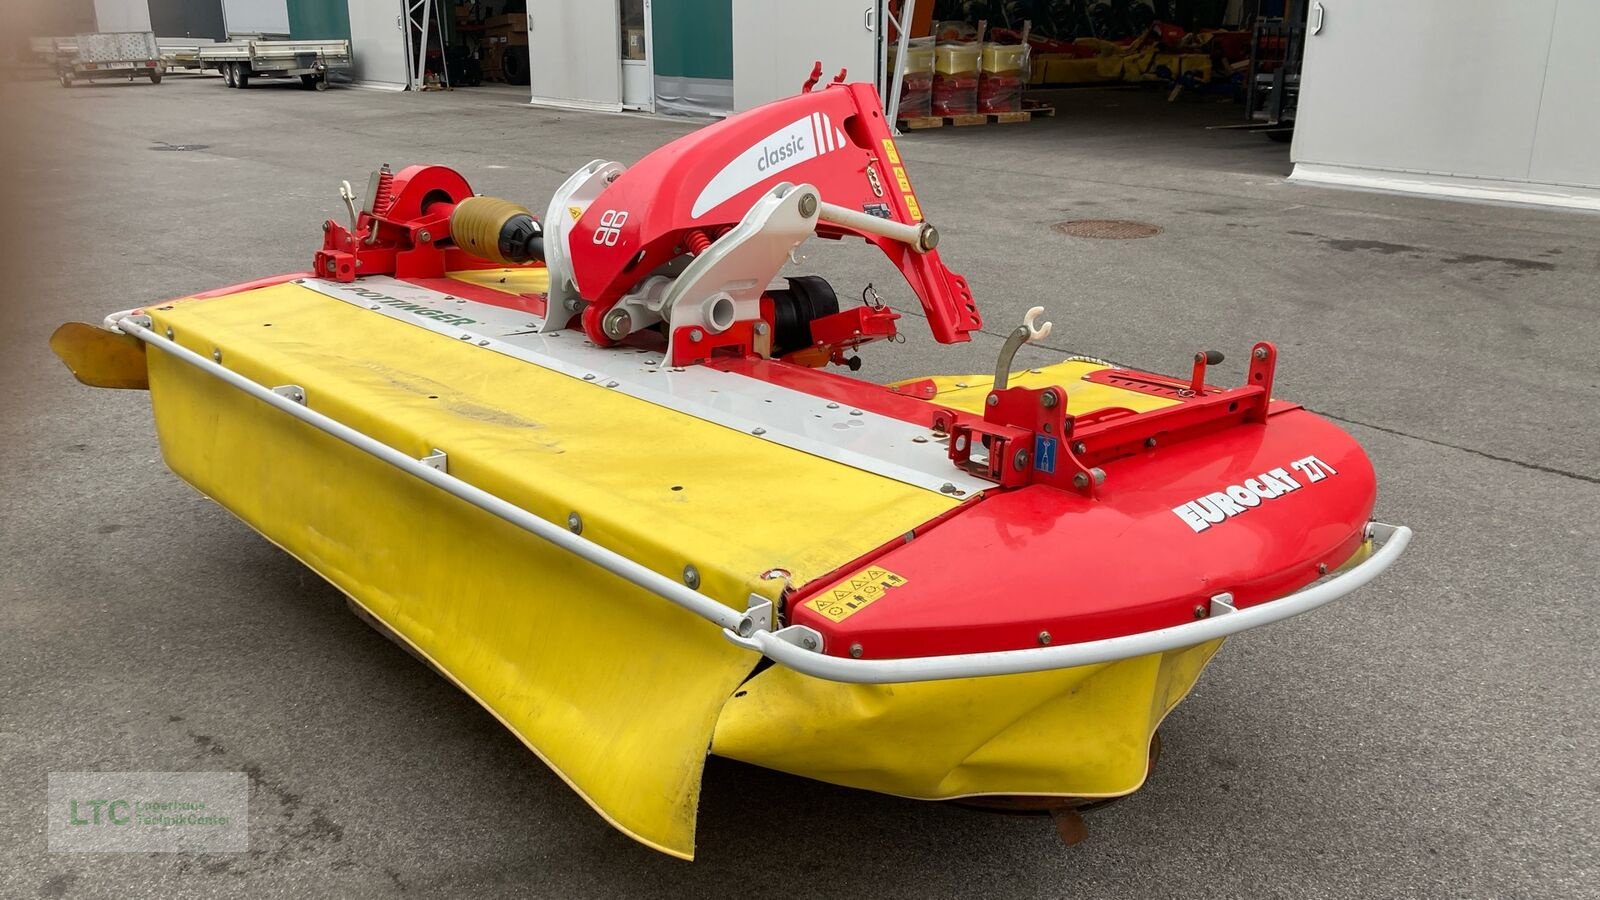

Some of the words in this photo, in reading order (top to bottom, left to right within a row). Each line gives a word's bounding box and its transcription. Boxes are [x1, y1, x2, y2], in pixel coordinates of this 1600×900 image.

[758, 135, 804, 171] classic
[1172, 467, 1303, 533] EUROCAT
[1290, 455, 1339, 483] 271
